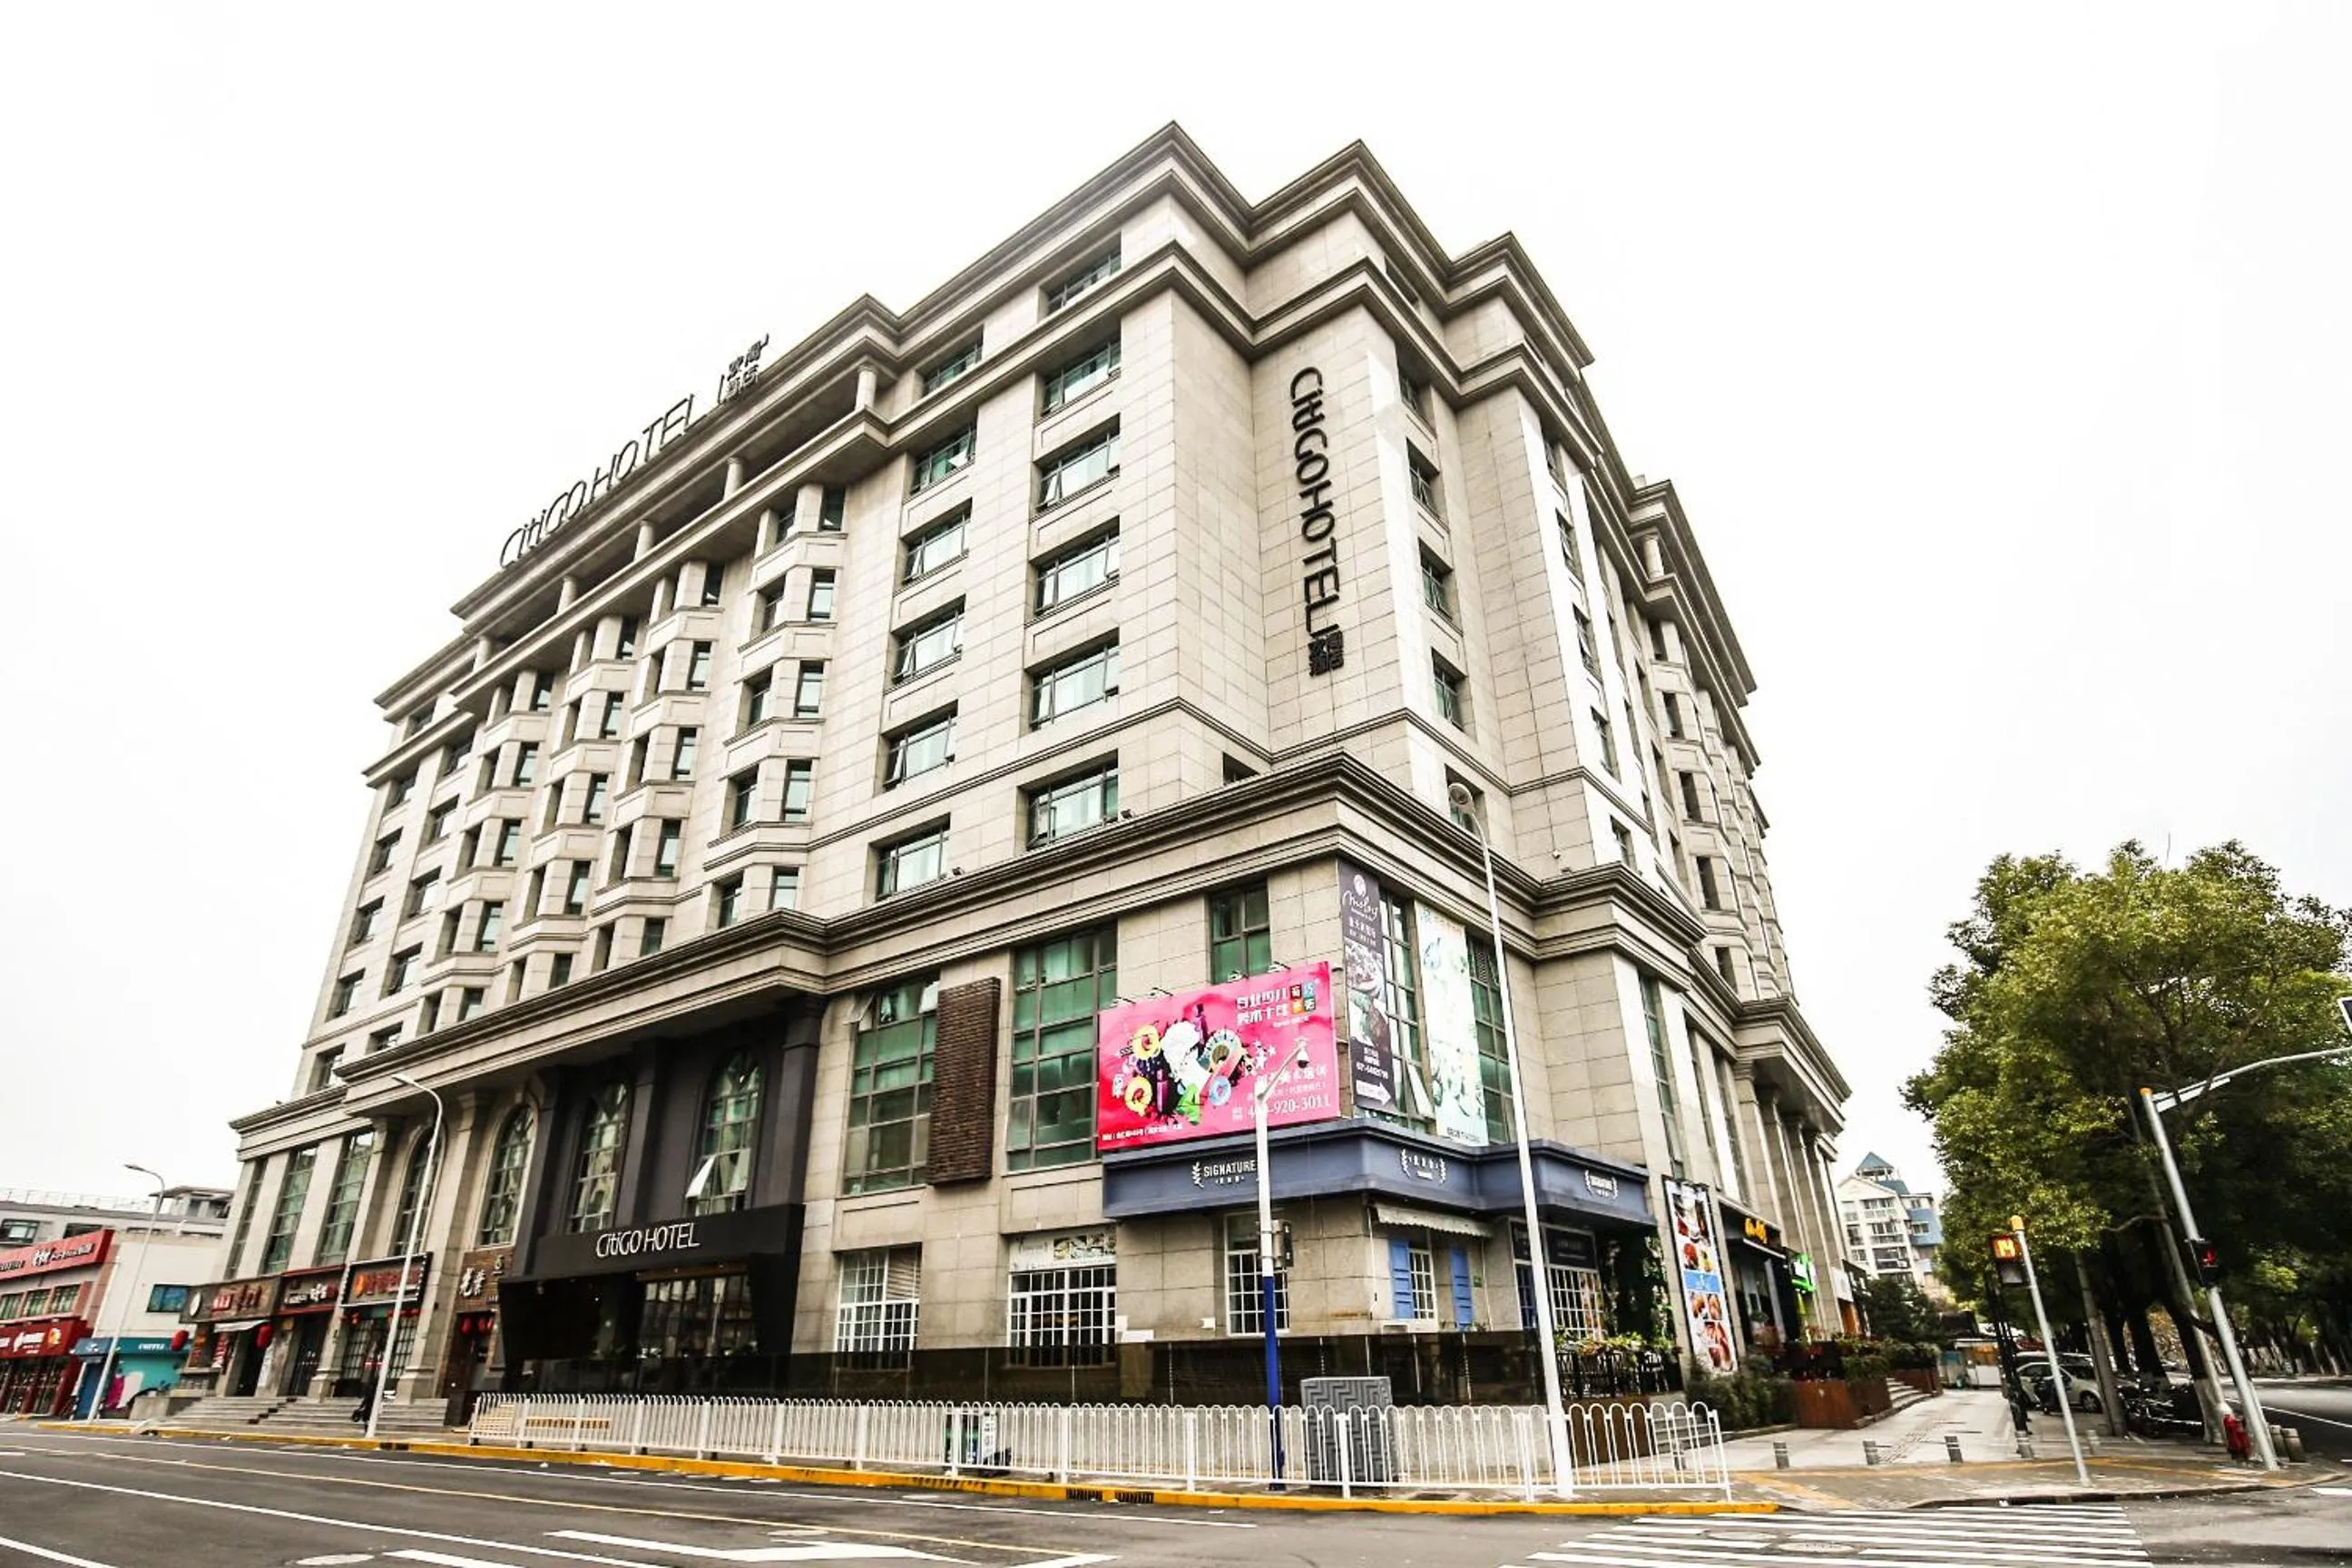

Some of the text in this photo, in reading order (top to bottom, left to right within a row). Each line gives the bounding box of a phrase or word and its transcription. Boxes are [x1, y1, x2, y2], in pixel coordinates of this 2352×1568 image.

[590, 394, 708, 505] HOTEL
[1298, 479, 1339, 633] HOTEL
[1203, 1160, 1257, 1178] SIGNATURE
[642, 1222, 701, 1252] HOTEL
